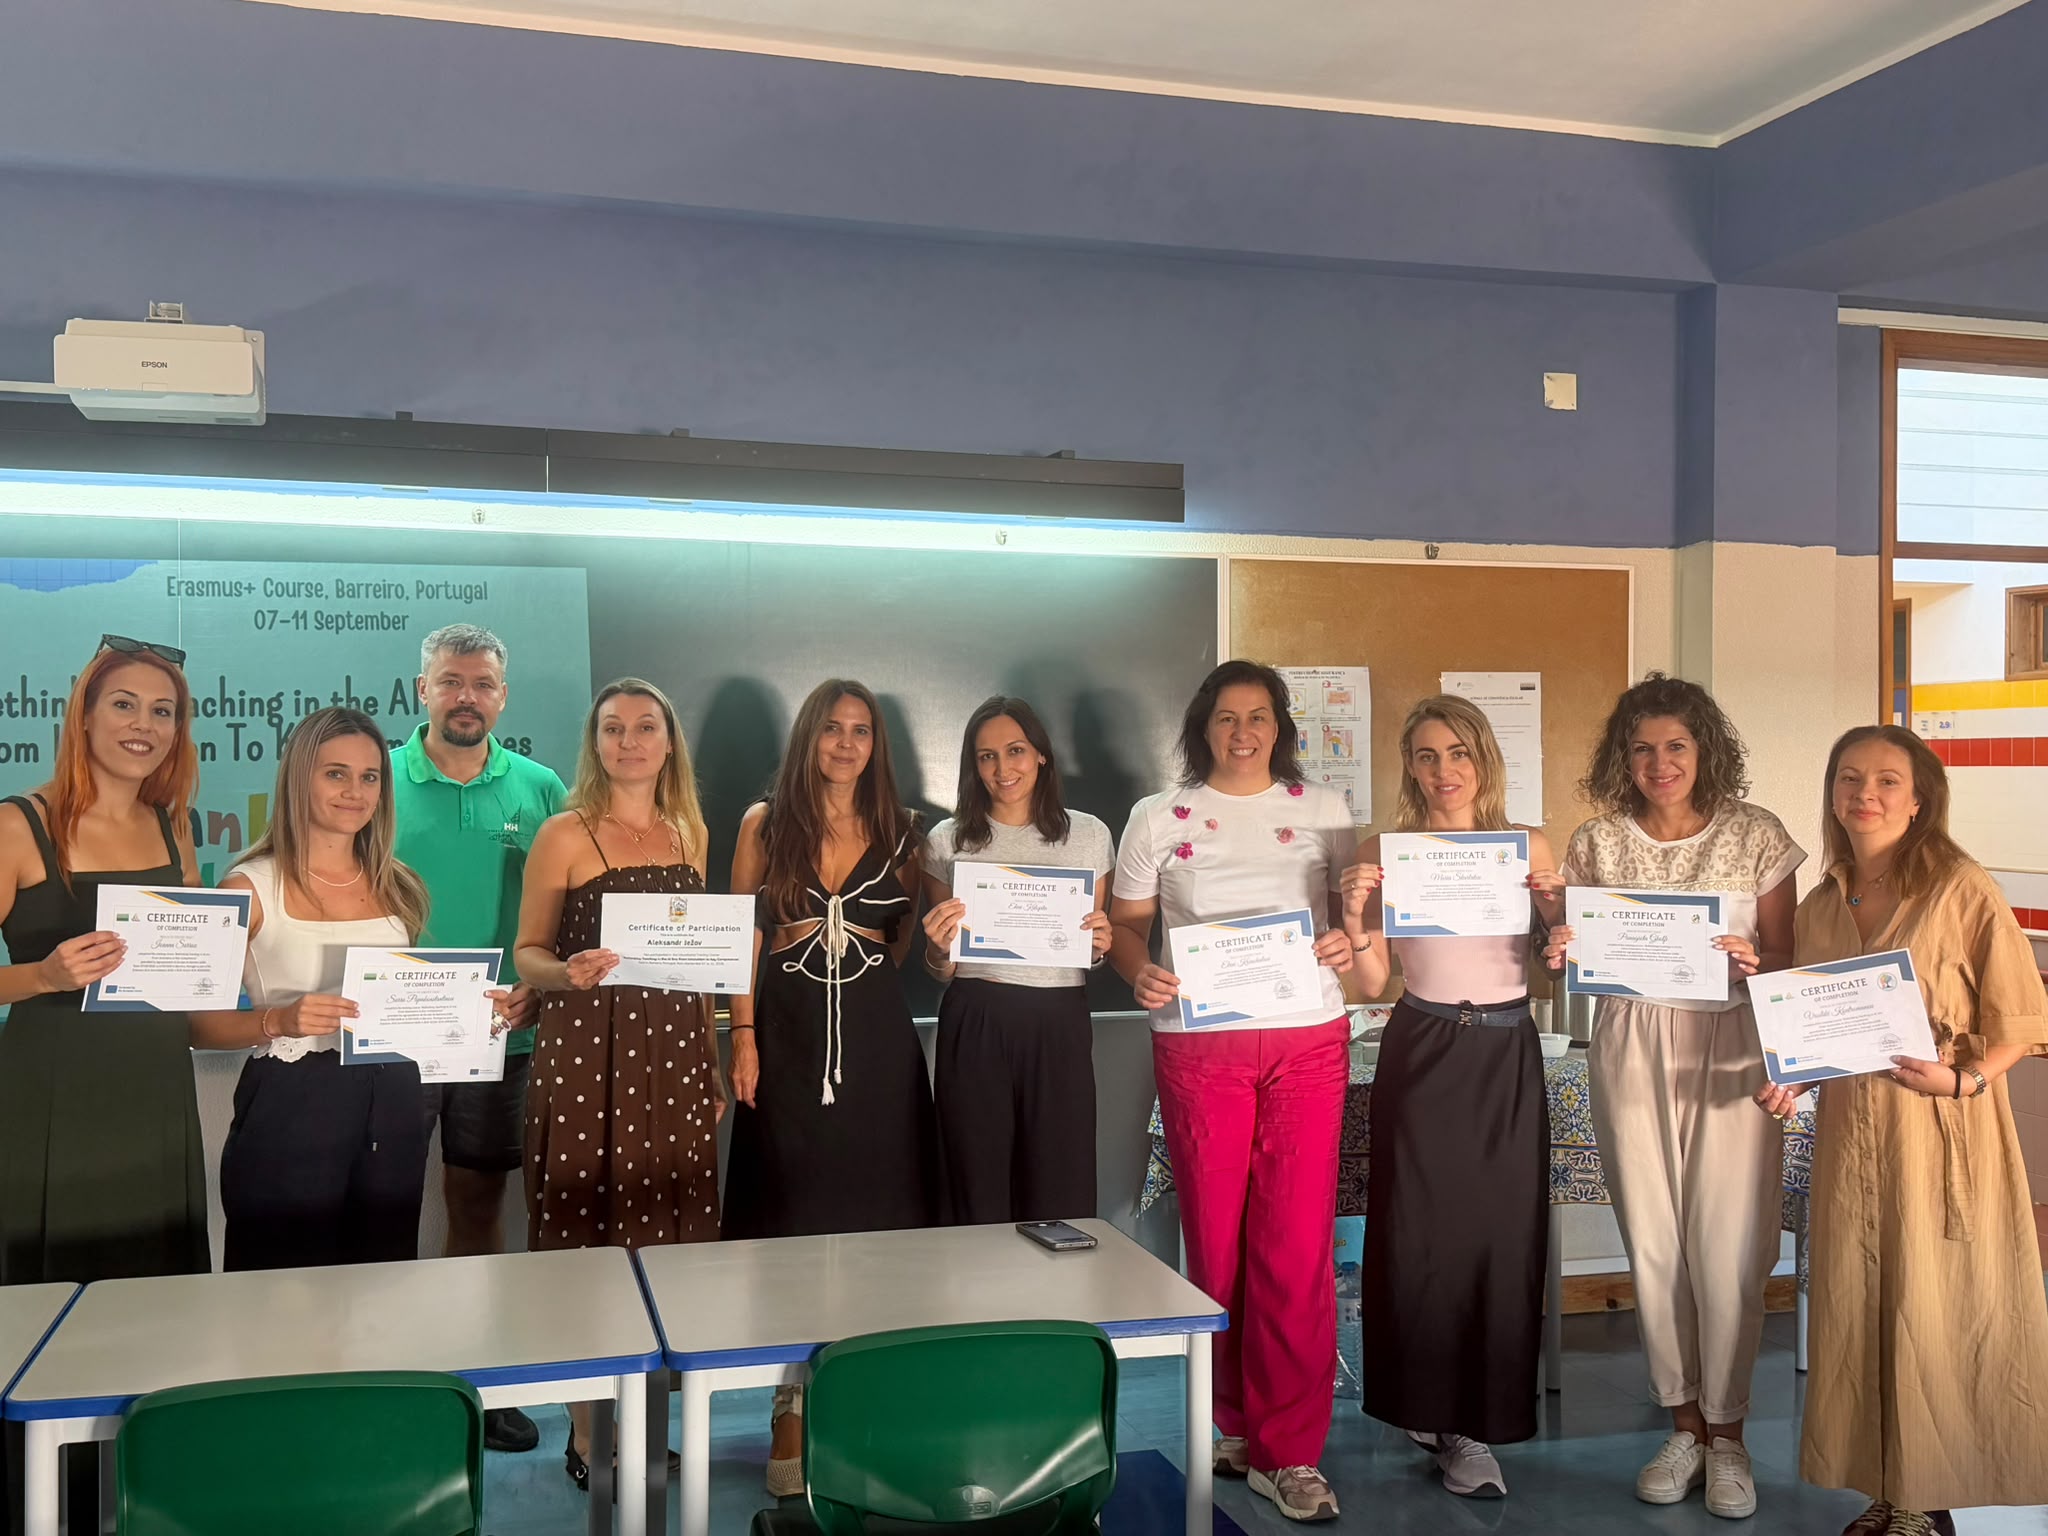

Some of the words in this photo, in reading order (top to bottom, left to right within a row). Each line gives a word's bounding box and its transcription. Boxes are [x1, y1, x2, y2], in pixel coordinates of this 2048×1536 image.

[141, 361, 168, 369] EPSON
[166, 576, 256, 598] Erasmus+
[263, 578, 329, 600] Course,
[335, 579, 410, 601] Barreiro,
[415, 580, 488, 604] Portugal
[313, 610, 409, 635] September
[330, 675, 379, 717] the
[226, 723, 264, 763] To
[504, 822, 518, 832] HH
[1426, 851, 1487, 860] CERTIFICATE
[1002, 882, 1057, 892] CERTIFICATE
[147, 912, 209, 924] CERTIFICATE
[1612, 910, 1676, 921] CERTIFICATE
[628, 924, 674, 932] Certificate
[676, 924, 685, 932] of
[688, 925, 741, 933] Participation
[1214, 932, 1273, 949] CERTIFICATE
[394, 971, 457, 981] CERTIFICATE
[1800, 978, 1868, 997] CERTIFICATE
